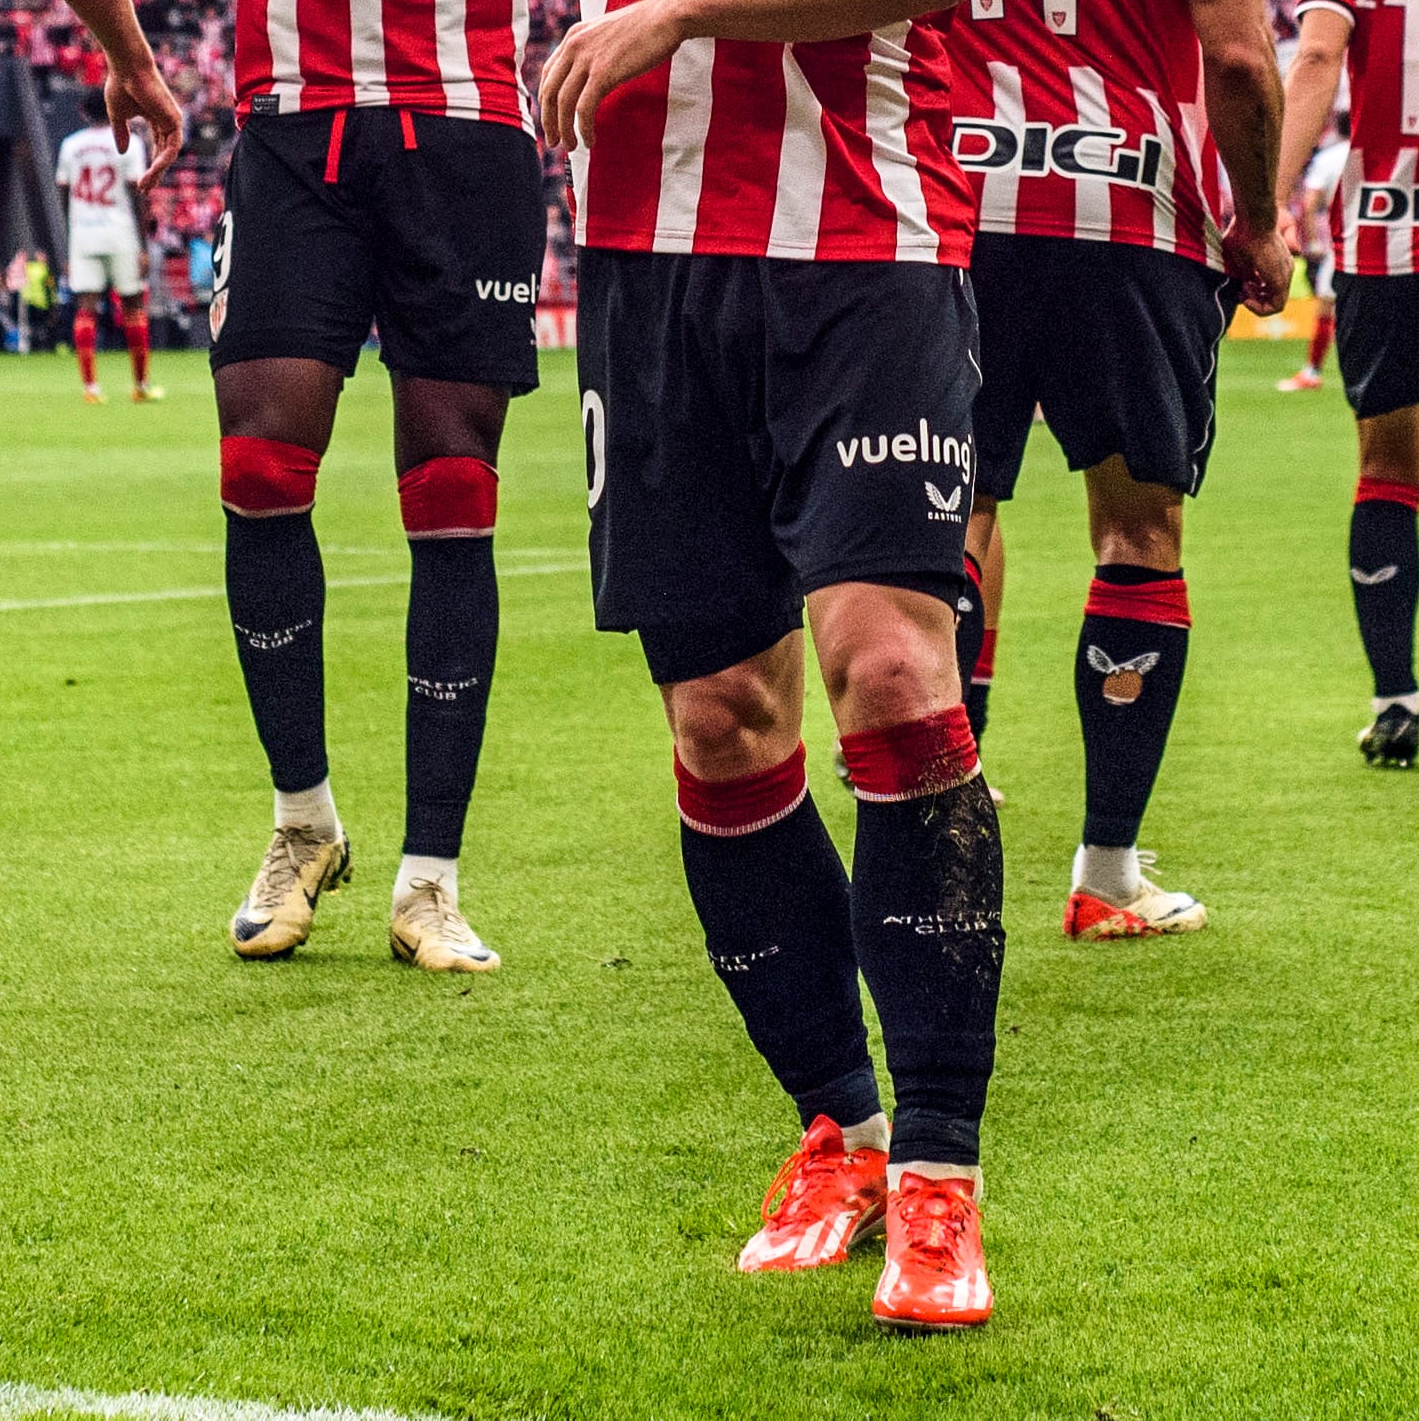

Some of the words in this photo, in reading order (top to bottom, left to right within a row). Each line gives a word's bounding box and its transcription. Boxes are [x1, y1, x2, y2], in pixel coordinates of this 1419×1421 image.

[74, 165, 116, 207] 42
[952, 122, 1163, 186] DIGI
[836, 417, 972, 485] vueling
